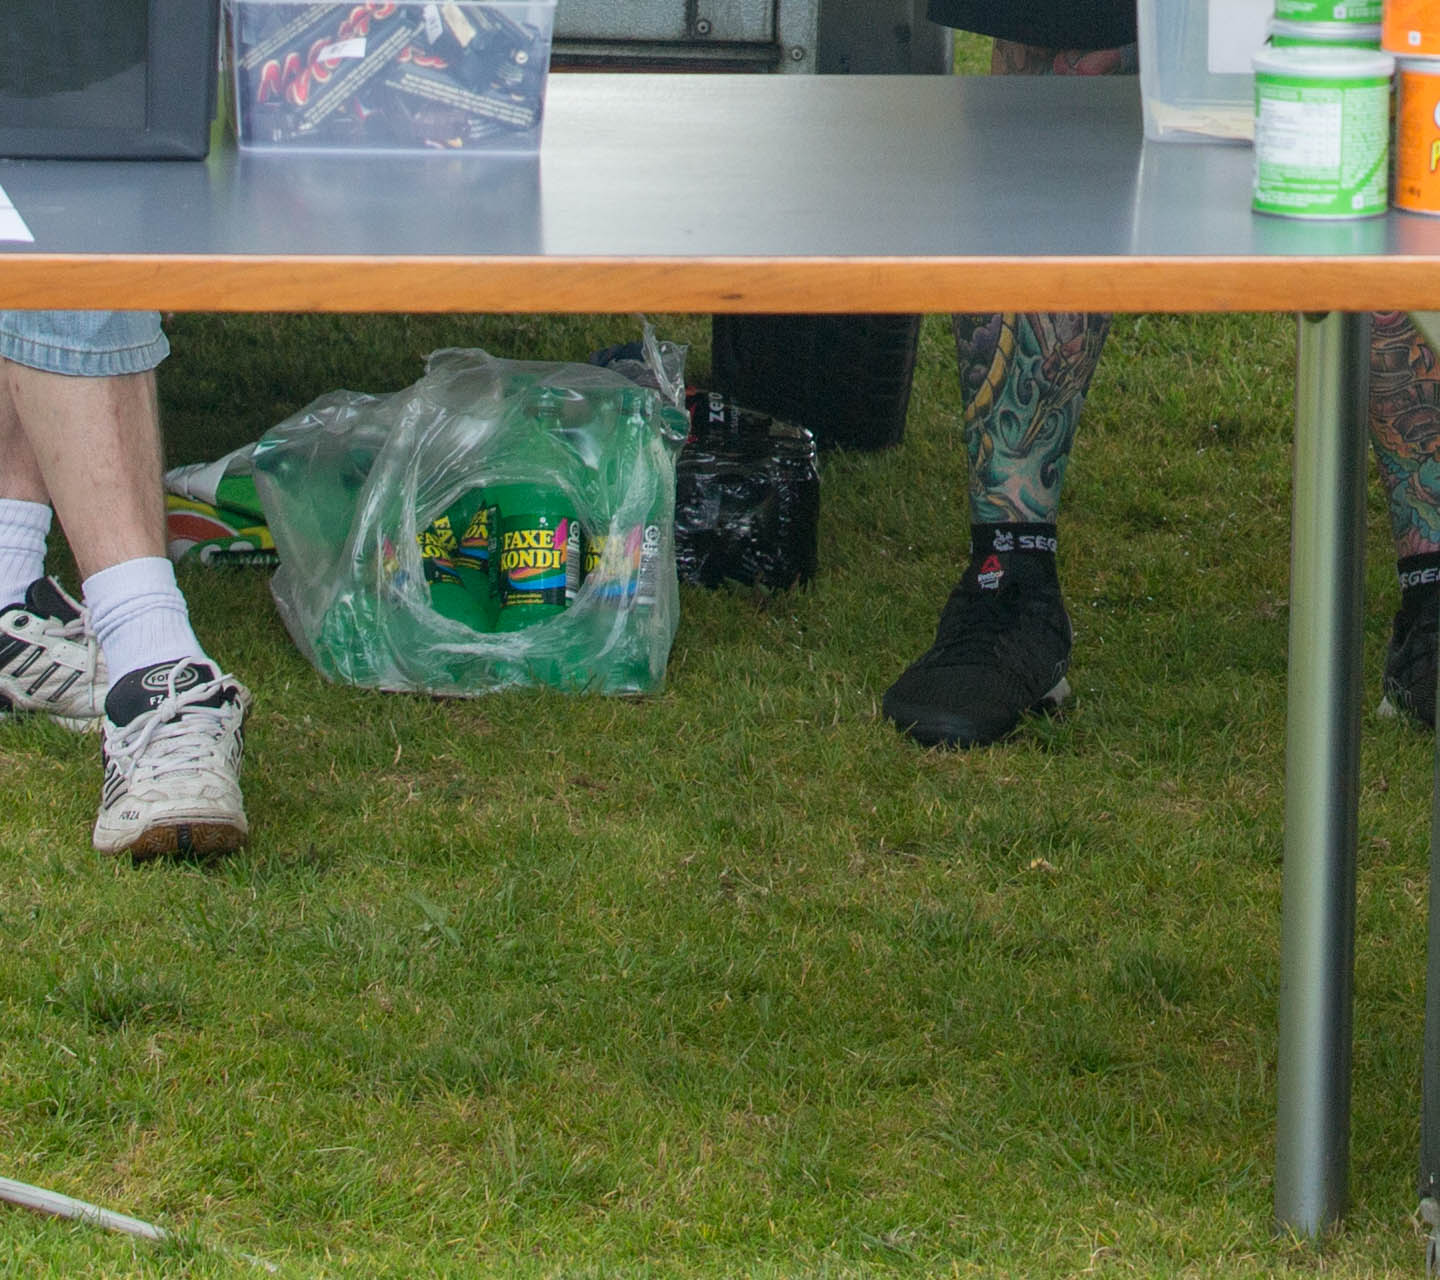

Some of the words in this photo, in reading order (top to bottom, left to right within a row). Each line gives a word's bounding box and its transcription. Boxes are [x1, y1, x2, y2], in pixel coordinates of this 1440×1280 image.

[503, 529, 555, 550] FAXE
[501, 549, 562, 570] KONDI
[151, 670, 189, 684] FOZA
